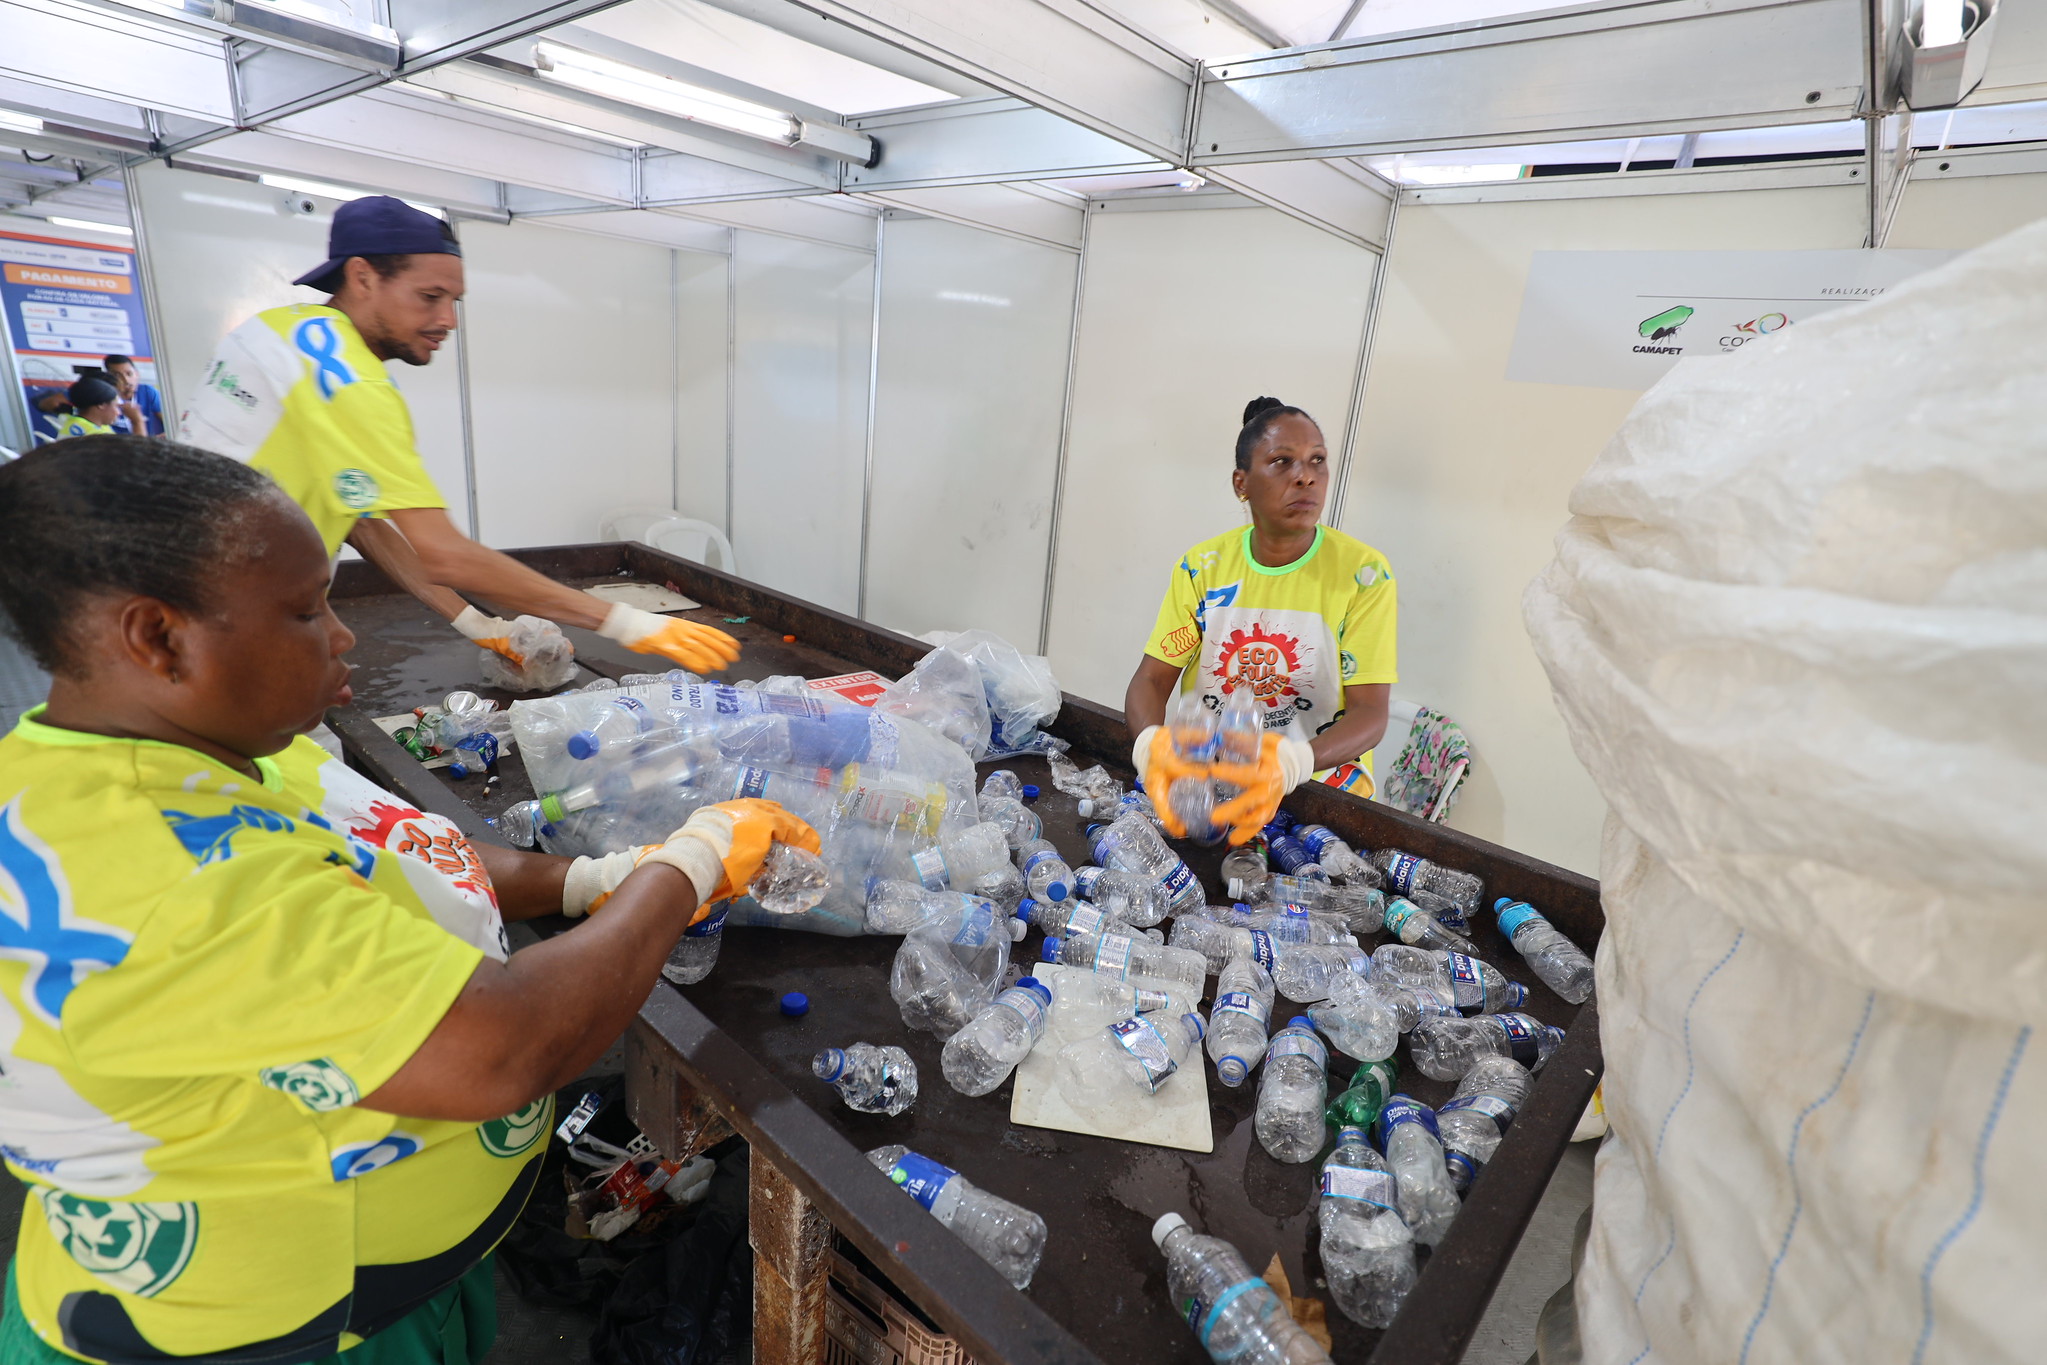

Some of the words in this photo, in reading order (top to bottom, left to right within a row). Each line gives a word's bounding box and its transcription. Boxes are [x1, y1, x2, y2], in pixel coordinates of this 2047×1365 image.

[20, 270, 119, 289] PAGAMENTO
[1632, 345, 1683, 356] CAMAPET
[1238, 647, 1279, 665] ECO
[809, 673, 877, 689] EXTINTOR
[1238, 665, 1276, 682] FOLIA
